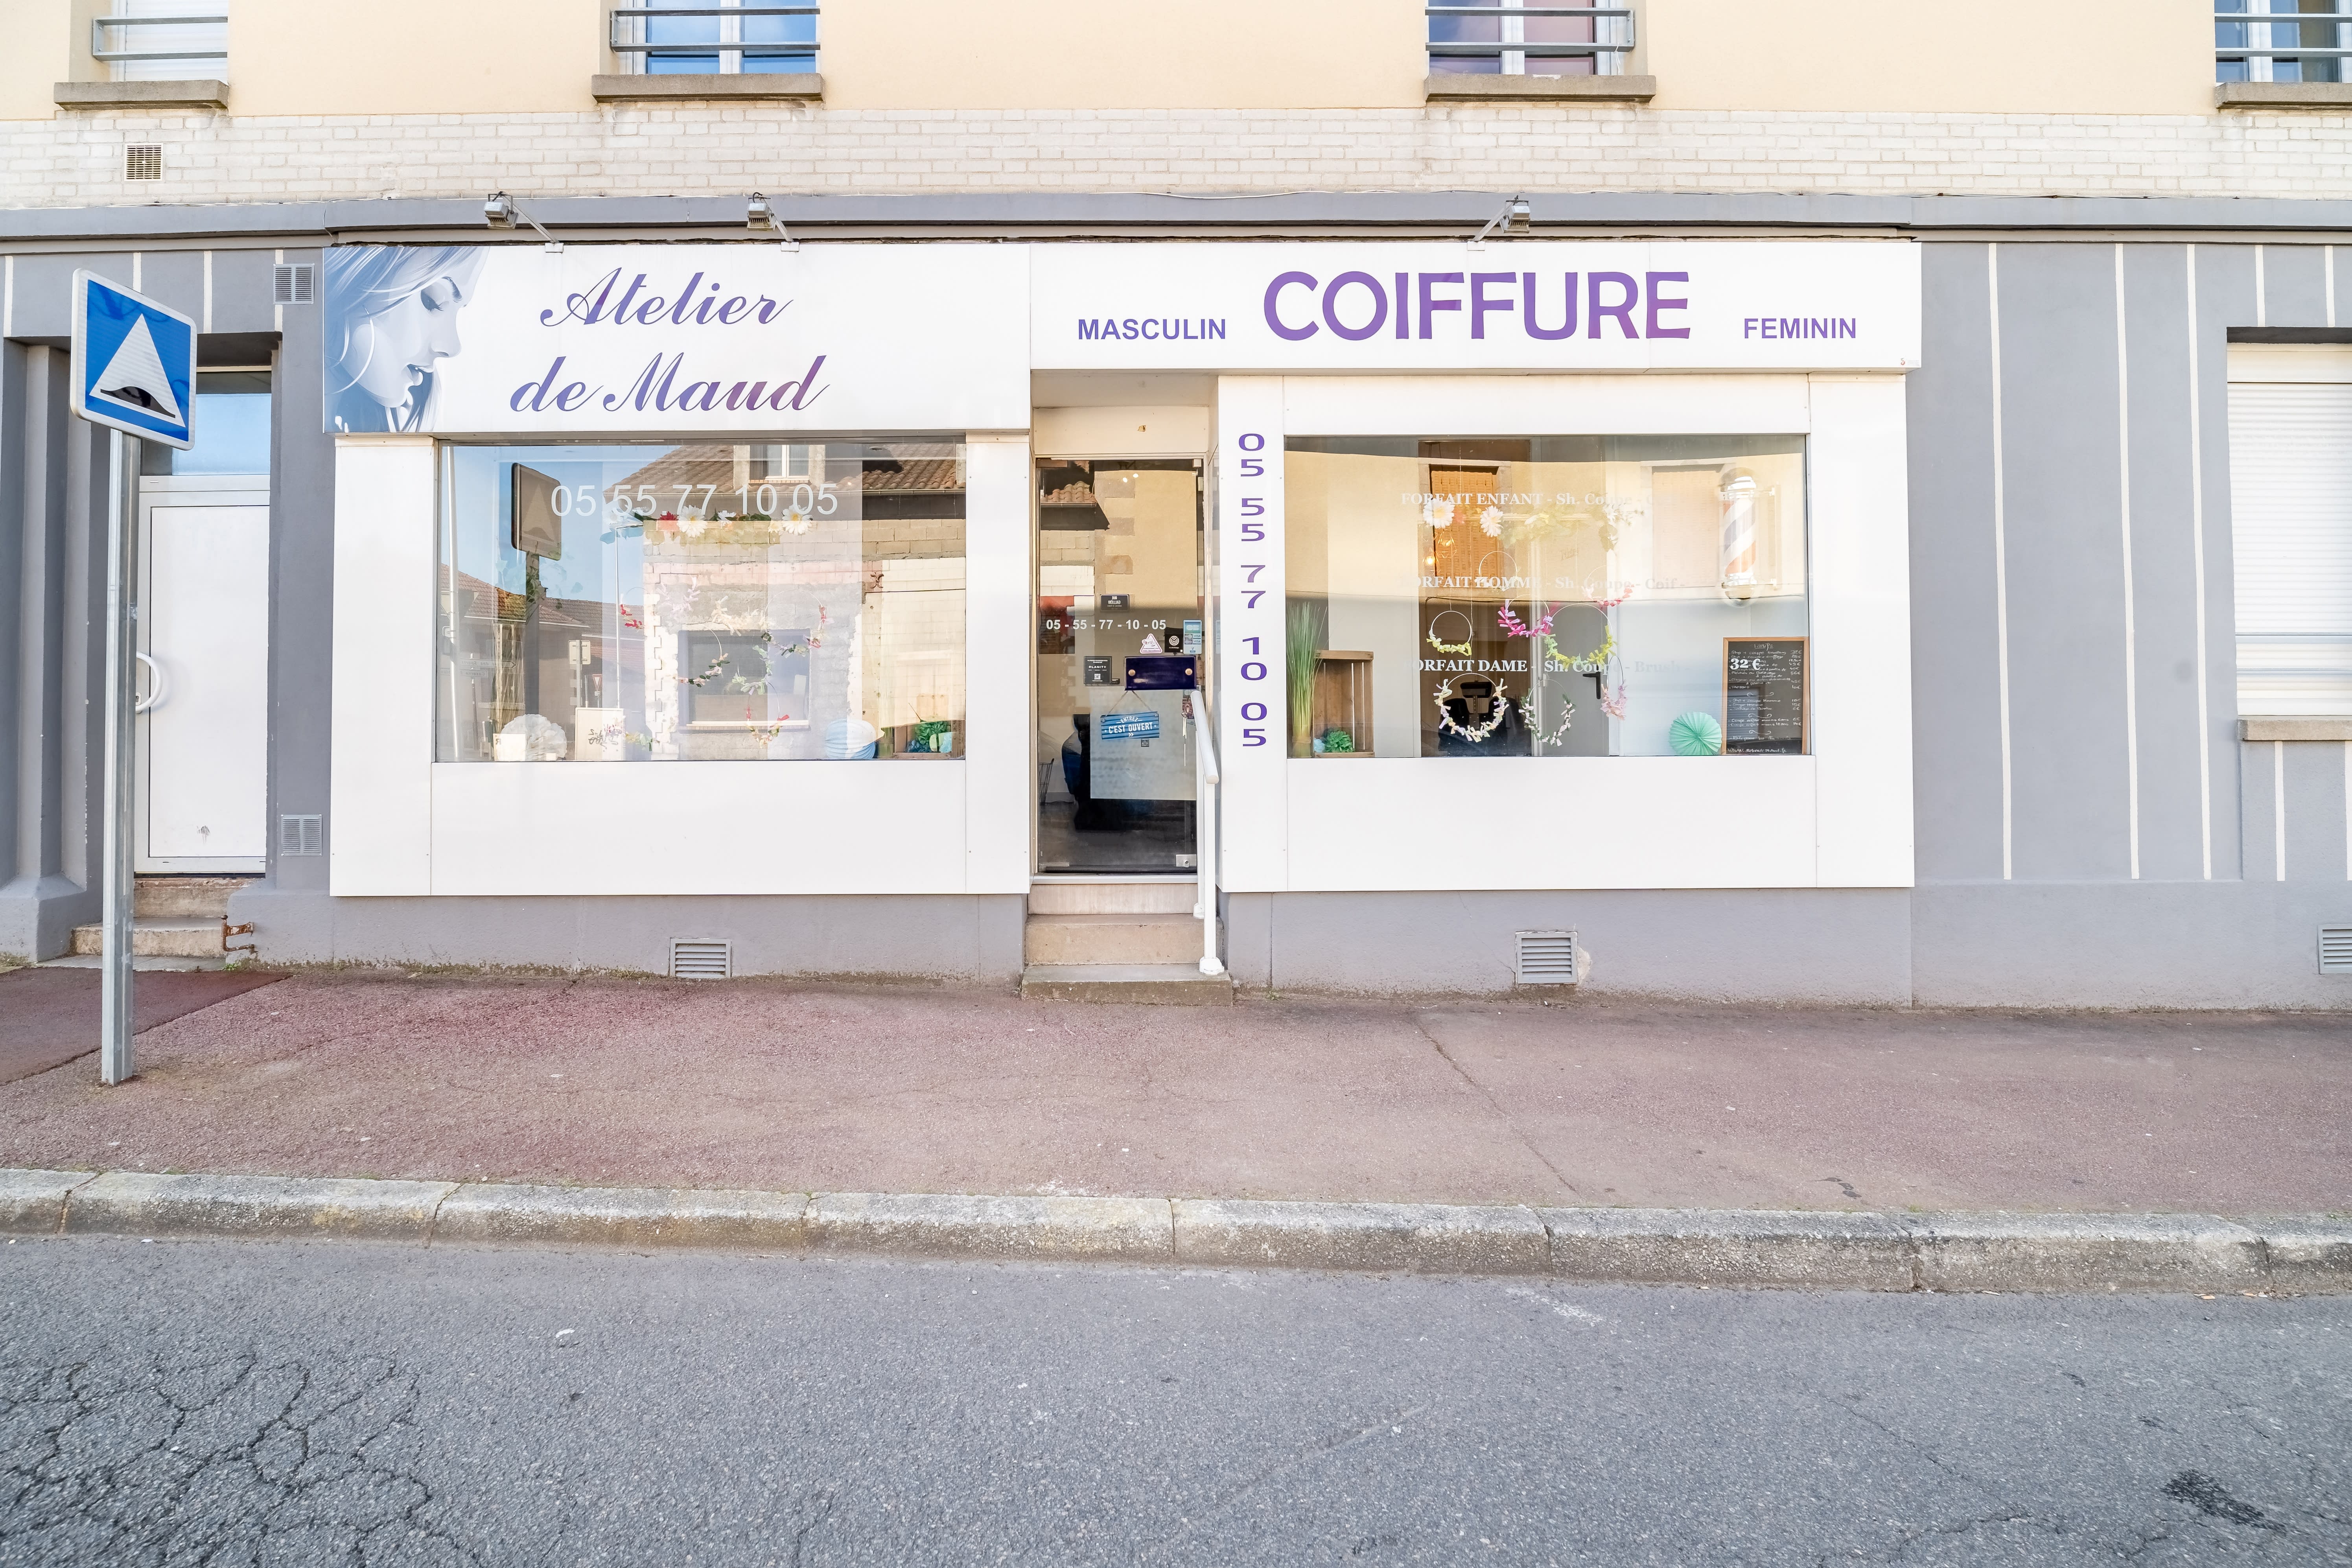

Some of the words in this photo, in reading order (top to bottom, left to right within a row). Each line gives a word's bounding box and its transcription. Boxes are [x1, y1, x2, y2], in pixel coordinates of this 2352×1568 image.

[540, 267, 794, 327] Atelier
[1263, 271, 1691, 341] COIFFURE
[1078, 319, 1226, 340] MASCULIN
[1744, 318, 1856, 339] FEMININ
[510, 356, 604, 412] de
[603, 352, 830, 412] Maud
[1401, 493, 1473, 505] FORFAIT
[1476, 493, 1543, 505] ENFANT
[1556, 492, 1580, 505] Sh.
[1403, 576, 1472, 588] ORFAIT
[1046, 619, 1061, 630] 05
[1073, 619, 1087, 630] 55
[1099, 619, 1113, 629] 77
[1125, 619, 1140, 630] 10
[1152, 619, 1166, 630] 05
[1403, 660, 1475, 671] ORFAIT
[1477, 660, 1527, 672] DAME
[1108, 724, 1125, 734] C'EST
[1128, 722, 1153, 732] OUVERT
